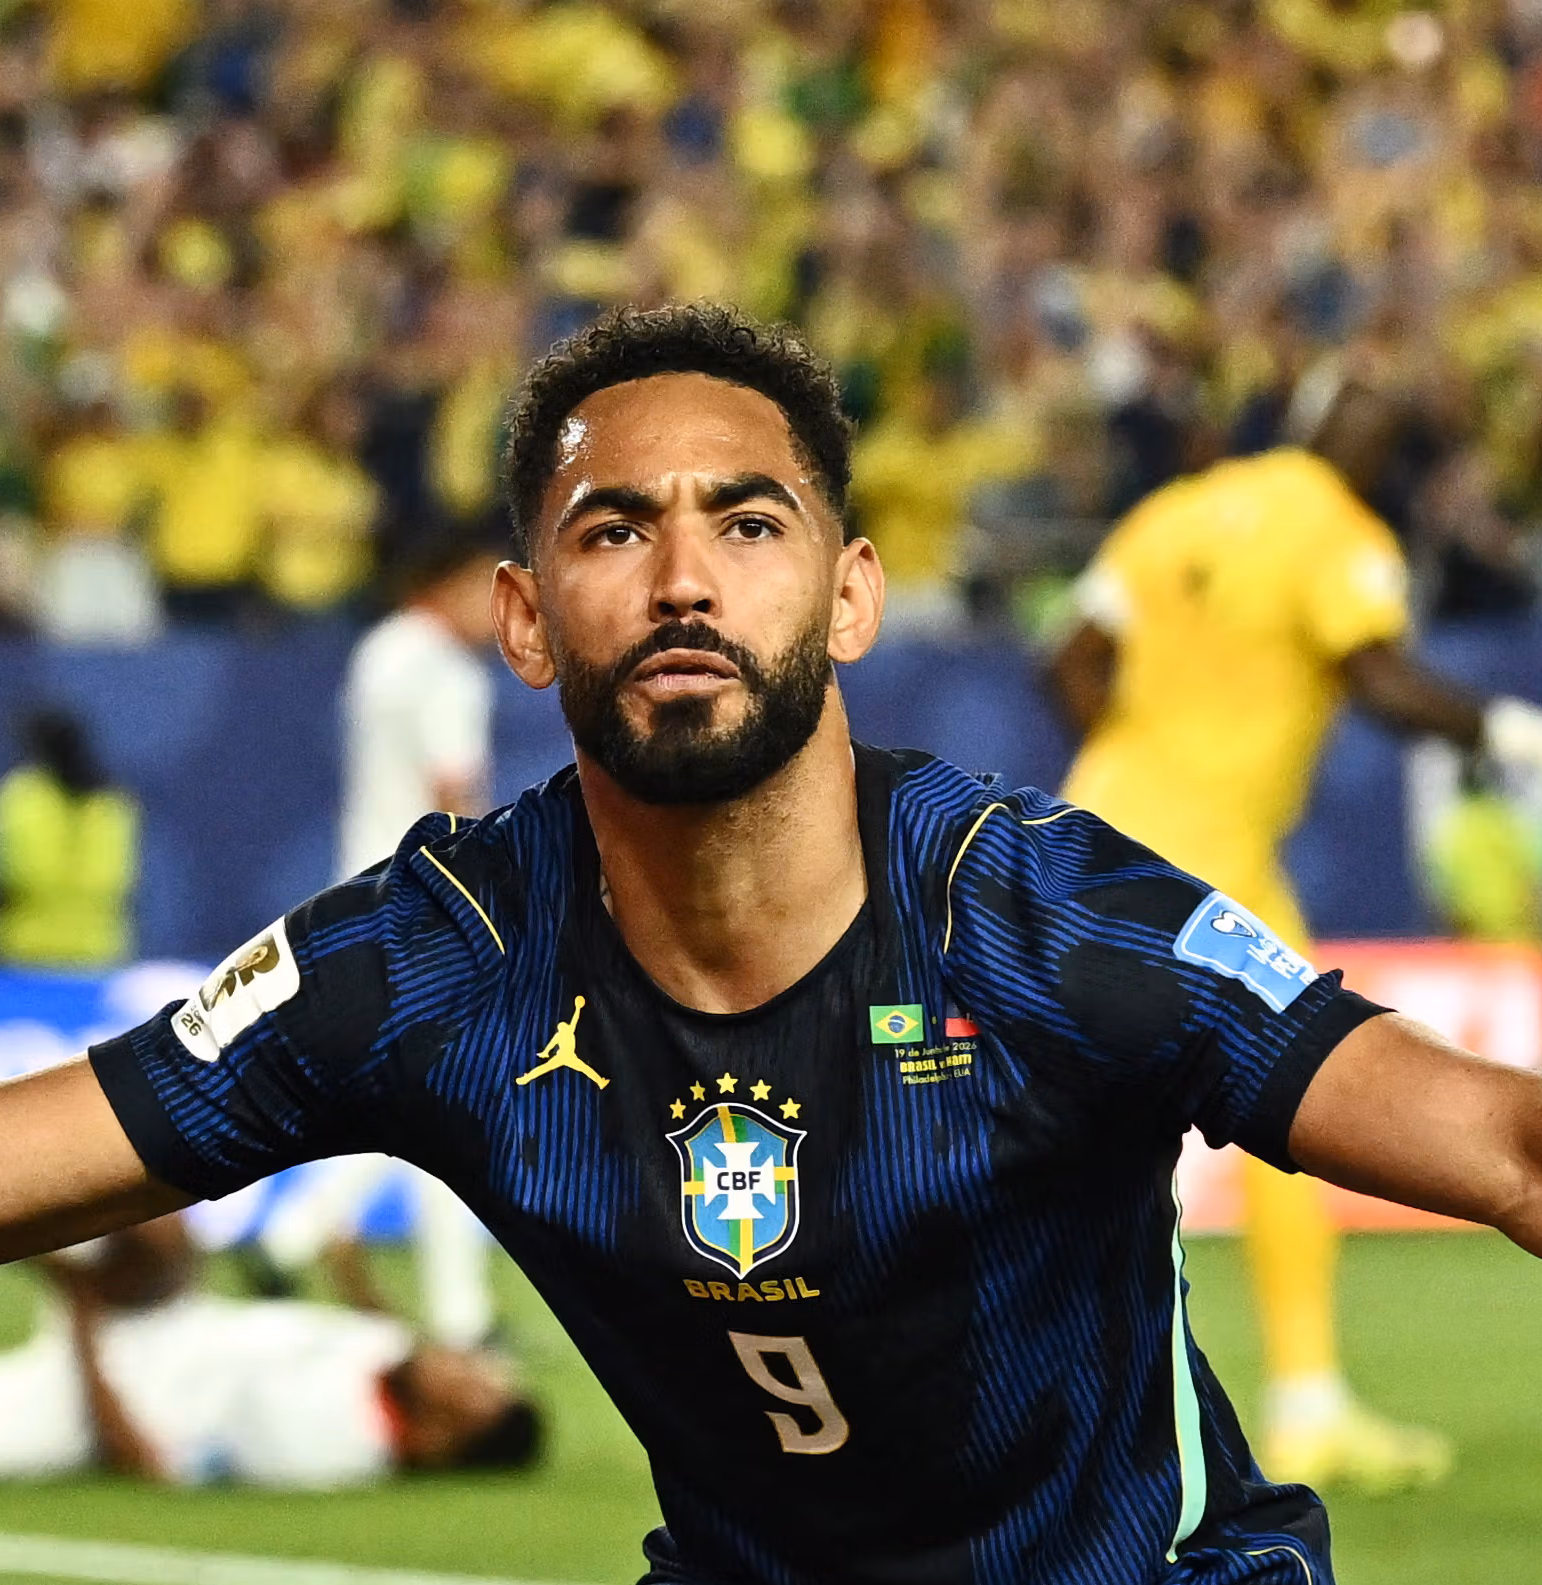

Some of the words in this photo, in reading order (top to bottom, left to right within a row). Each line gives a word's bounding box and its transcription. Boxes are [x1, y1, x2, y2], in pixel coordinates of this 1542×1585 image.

[180, 1013, 202, 1037] 26
[894, 1048, 906, 1058] 19
[952, 1041, 977, 1051] 2026
[716, 1171, 761, 1191] CBF
[683, 1276, 820, 1302] BRASIL
[728, 1329, 850, 1455] 9
